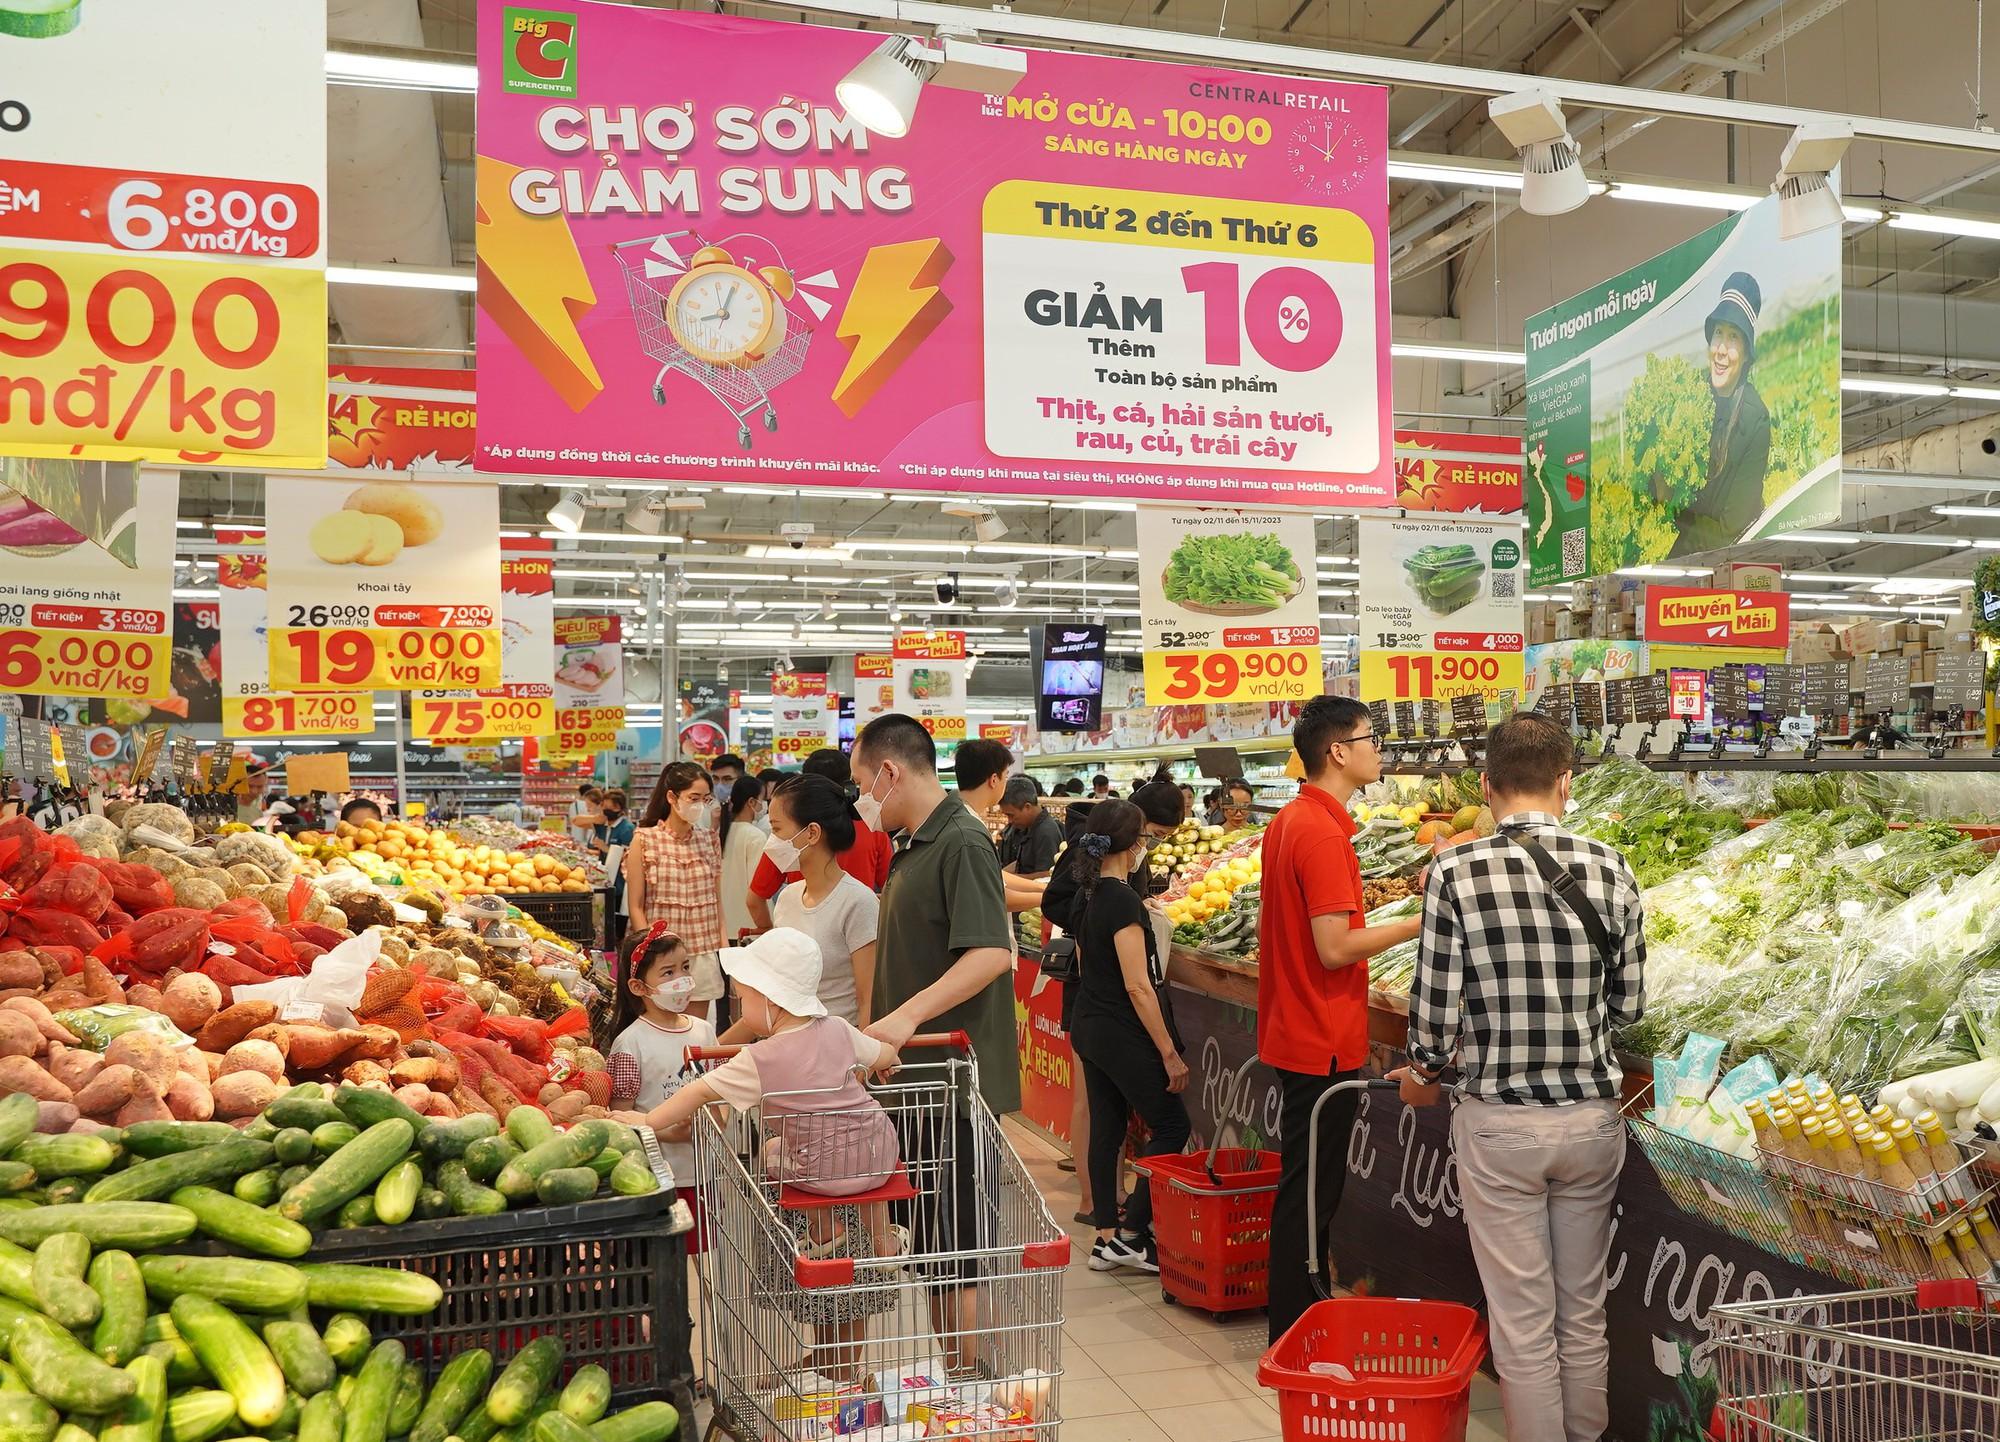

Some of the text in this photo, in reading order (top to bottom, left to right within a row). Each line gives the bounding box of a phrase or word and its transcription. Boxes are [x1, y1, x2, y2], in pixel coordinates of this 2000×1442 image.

[513, 17, 548, 38] Big
[508, 80, 572, 93] SUPERCENTER
[981, 104, 1004, 117] lúc
[1006, 92, 1272, 146] MỞ CỬA 10:00
[538, 96, 869, 161] CHỢ SỚM
[1045, 133, 1248, 169] SÁNG HÀNG NGÀY
[510, 153, 913, 216] GIẢM SUNG
[107, 180, 298, 250] 6.800
[1035, 201, 1319, 249] Thứ 2 đến Thứ 6
[182, 228, 288, 257] vnđ/kg
[1024, 281, 1163, 334] GIẢM
[1530, 279, 1658, 351] Tươi ngon mỗi ngày
[1088, 337, 1156, 359] Thêm
[1094, 368, 1279, 395] Toàn bộ sản phẩm
[1539, 386, 1554, 400] lách
[1570, 373, 1587, 389] xanh
[1542, 391, 1573, 412] VietGAP
[396, 405, 429, 427] RẺ
[1036, 396, 1333, 437] Thịt, cá, hải sản tươi,
[1076, 428, 1299, 463] rau, củ, trái cây
[516, 447, 556, 462] dụng
[559, 448, 599, 463] đồng
[601, 450, 632, 463] thời
[634, 453, 660, 464] các
[663, 455, 718, 468] chương
[720, 456, 757, 468] trình
[759, 456, 812, 473] khuyến
[843, 461, 881, 473] khác.
[931, 464, 947, 478] áp
[951, 465, 985, 480] dụng
[988, 467, 1009, 479] khi
[1011, 471, 1040, 481] mua
[1042, 470, 1061, 482] tại
[1063, 470, 1090, 482] siêu
[1092, 471, 1114, 485] thị,
[1116, 471, 1164, 485] KHÔNG
[1167, 475, 1183, 488] áp
[1185, 477, 1217, 489] dụng
[1220, 478, 1239, 489] khi
[1242, 481, 1269, 491] mua
[1272, 482, 1294, 492] qua
[1297, 481, 1344, 495] Hotline,
[1346, 483, 1387, 495] Online.
[1451, 465, 1518, 486] RẺ HƠN
[1183, 518, 1202, 526] ngày
[1203, 517, 1224, 525] 02/11
[1241, 516, 1282, 525] 15/11/2023
[1402, 524, 1419, 532] ngày
[1421, 524, 1440, 532] 02/11
[1456, 525, 1493, 534] 15/11/2023
[514, 562, 549, 575] HƠN
[22, 586, 49, 598] lang
[53, 587, 90, 601] giống
[94, 591, 121, 602] nhật
[357, 582, 412, 594] Khoai tây
[36, 610, 158, 631] TIẾT KIỆM 3.600
[378, 608, 399, 620] TIẾT
[437, 606, 492, 628] 7.000
[1394, 605, 1412, 614] baby
[1663, 598, 1731, 621] Khuyến
[1736, 612, 1771, 631] Mãi!
[1393, 620, 1412, 628] 500g
[1270, 627, 1316, 646] 13.000
[1482, 634, 1519, 651] 4.000
[287, 630, 486, 685] 19.000
[1604, 649, 1633, 669] Bơ
[49, 669, 150, 696] vnđ/kg
[390, 662, 480, 684] vnđ/kg
[1164, 652, 1308, 700] 39.900
[1387, 656, 1500, 698] 11.900
[243, 697, 357, 732] 81.700
[425, 701, 542, 735] 75.000
[1035, 1012, 1050, 1035] LUÔN
[1035, 1039, 1071, 1089] RẺ HƠN
[1202, 1036, 1256, 1127] Rau
